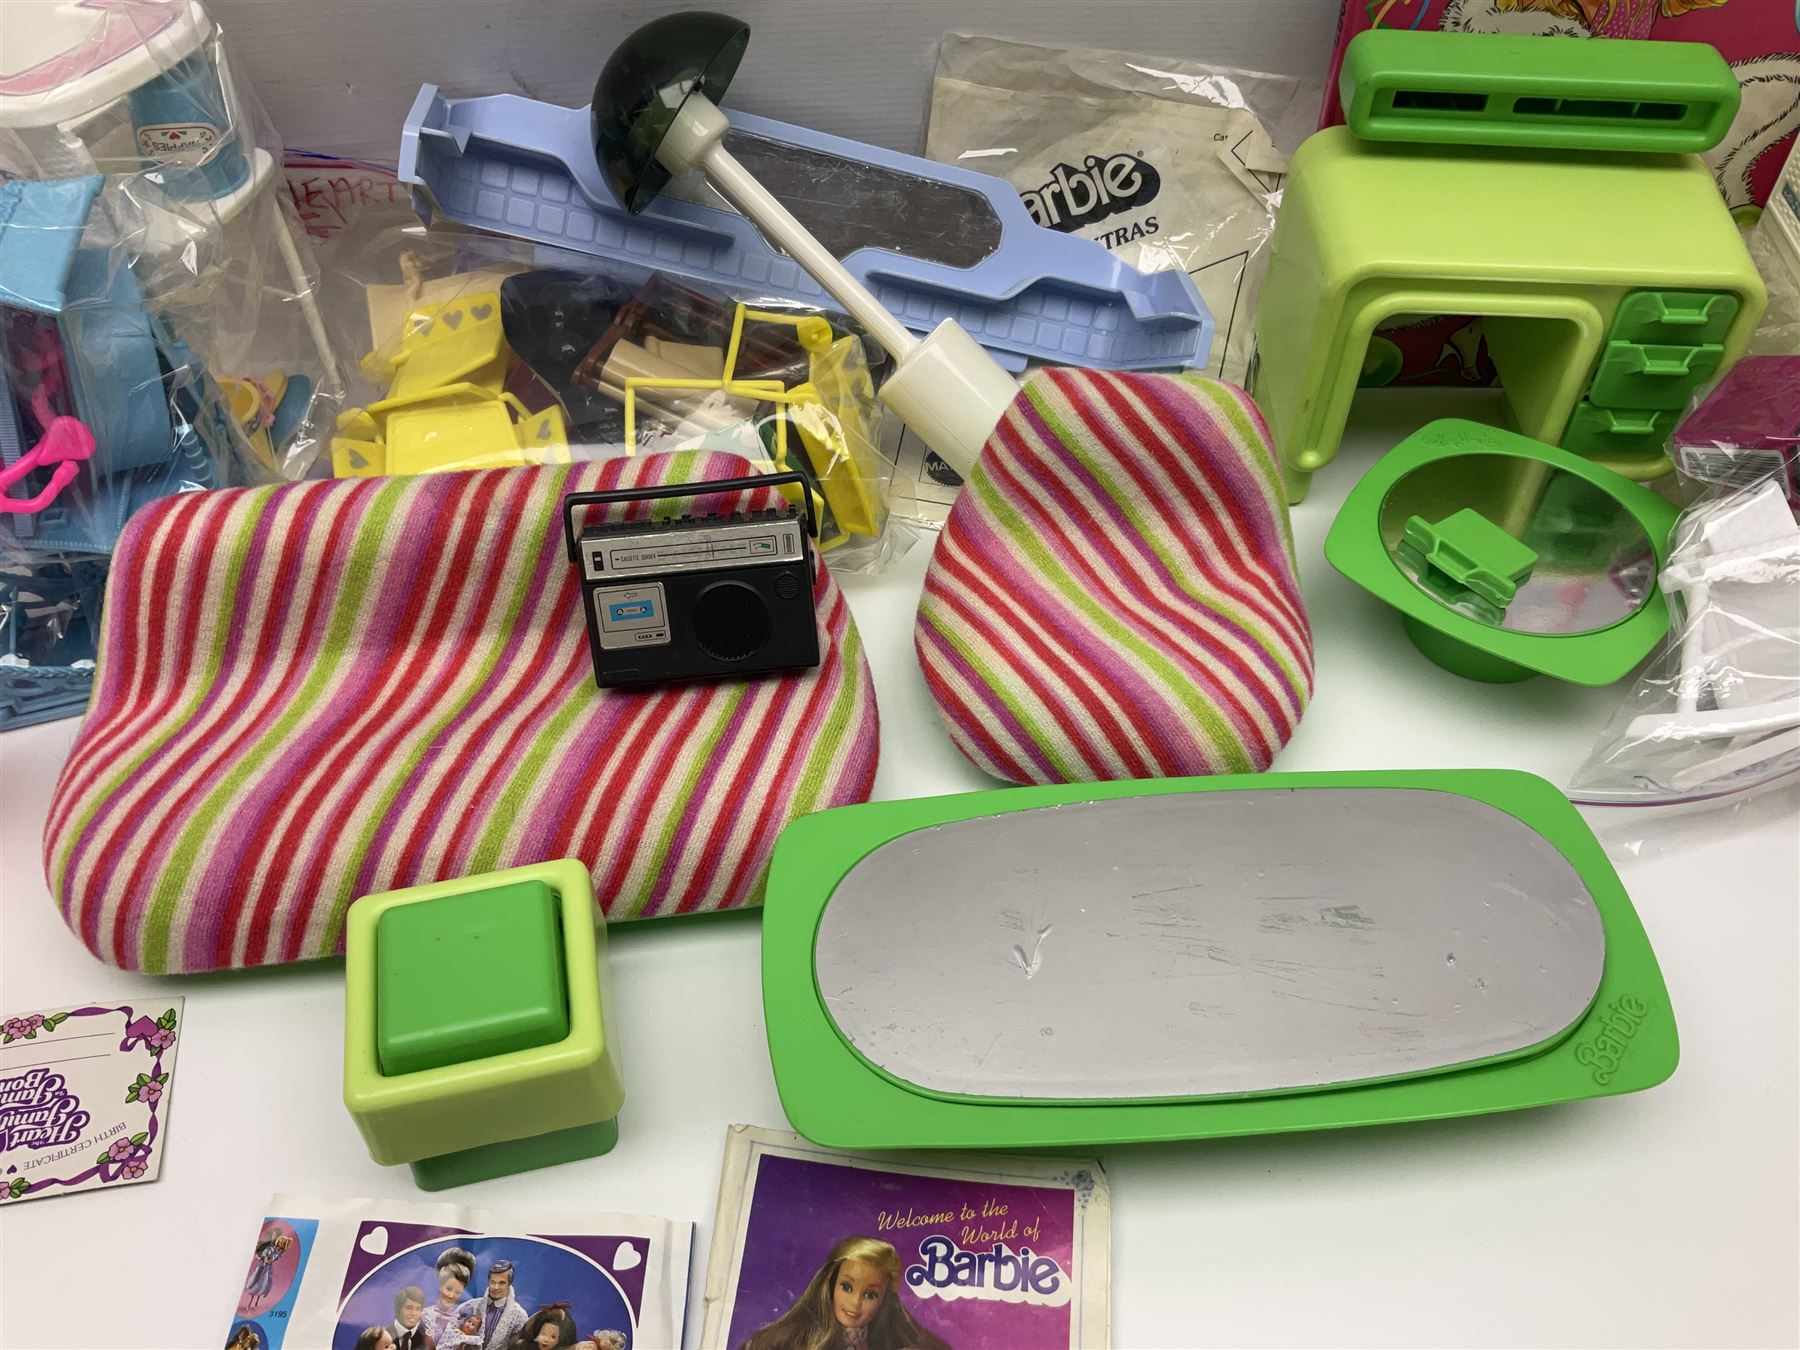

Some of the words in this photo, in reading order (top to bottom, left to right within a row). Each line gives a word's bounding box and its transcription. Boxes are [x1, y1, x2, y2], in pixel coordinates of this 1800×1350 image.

[1020, 154, 1143, 227] arbie
[1095, 216, 1160, 250] TRAS
[1575, 994, 1648, 1086] Barbie
[0, 1097, 77, 1130] Famil
[9, 1113, 87, 1148] Heart
[93, 1121, 127, 1144] BIRTH
[23, 1138, 92, 1171] CERTIFICATE
[877, 1207, 955, 1231] Welcome
[959, 1202, 977, 1220] to
[982, 1198, 1009, 1217] the
[961, 1219, 1019, 1245] World
[1023, 1216, 1042, 1242] of
[905, 1235, 1063, 1297] Barbie
[268, 1310, 288, 1318] 3195
